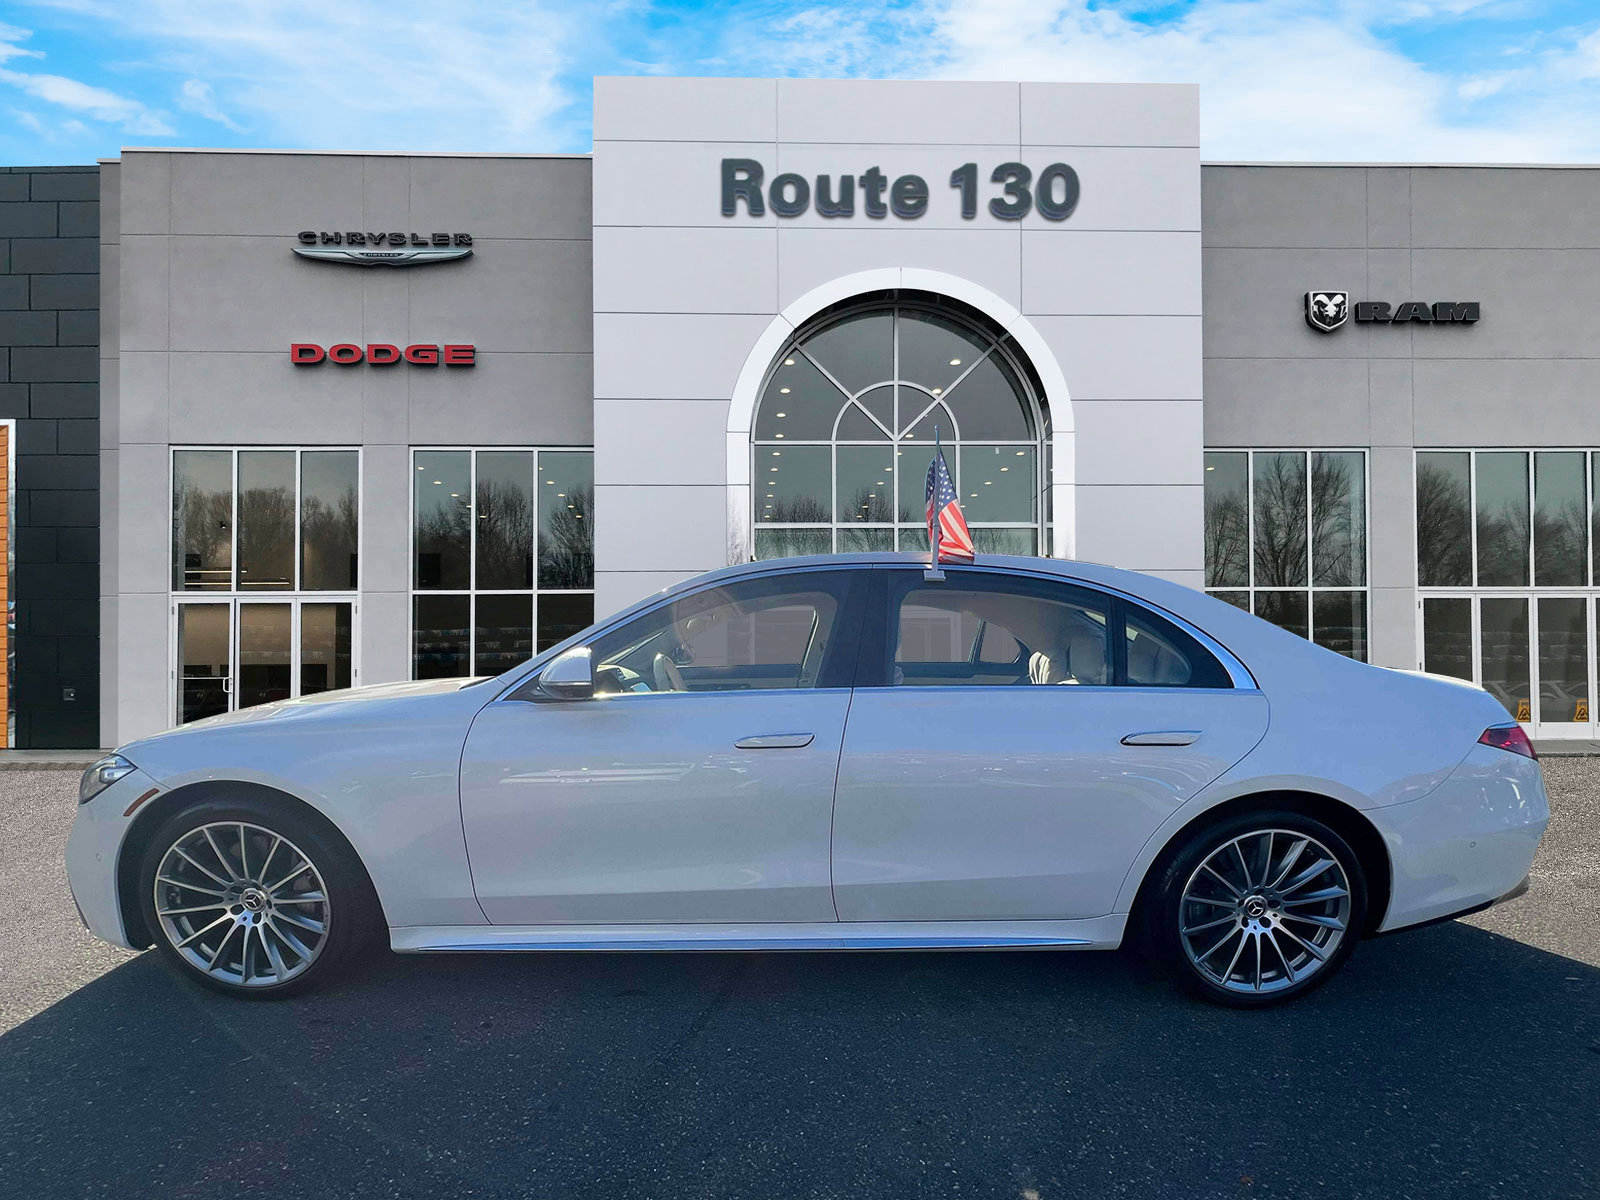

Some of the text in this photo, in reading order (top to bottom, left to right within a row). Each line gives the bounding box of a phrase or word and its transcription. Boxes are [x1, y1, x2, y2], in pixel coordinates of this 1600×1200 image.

[721, 158, 1080, 220] Route 130
[298, 231, 473, 245] CHRYSLER
[1354, 302, 1480, 323] RAM
[291, 343, 475, 366] DODGE
